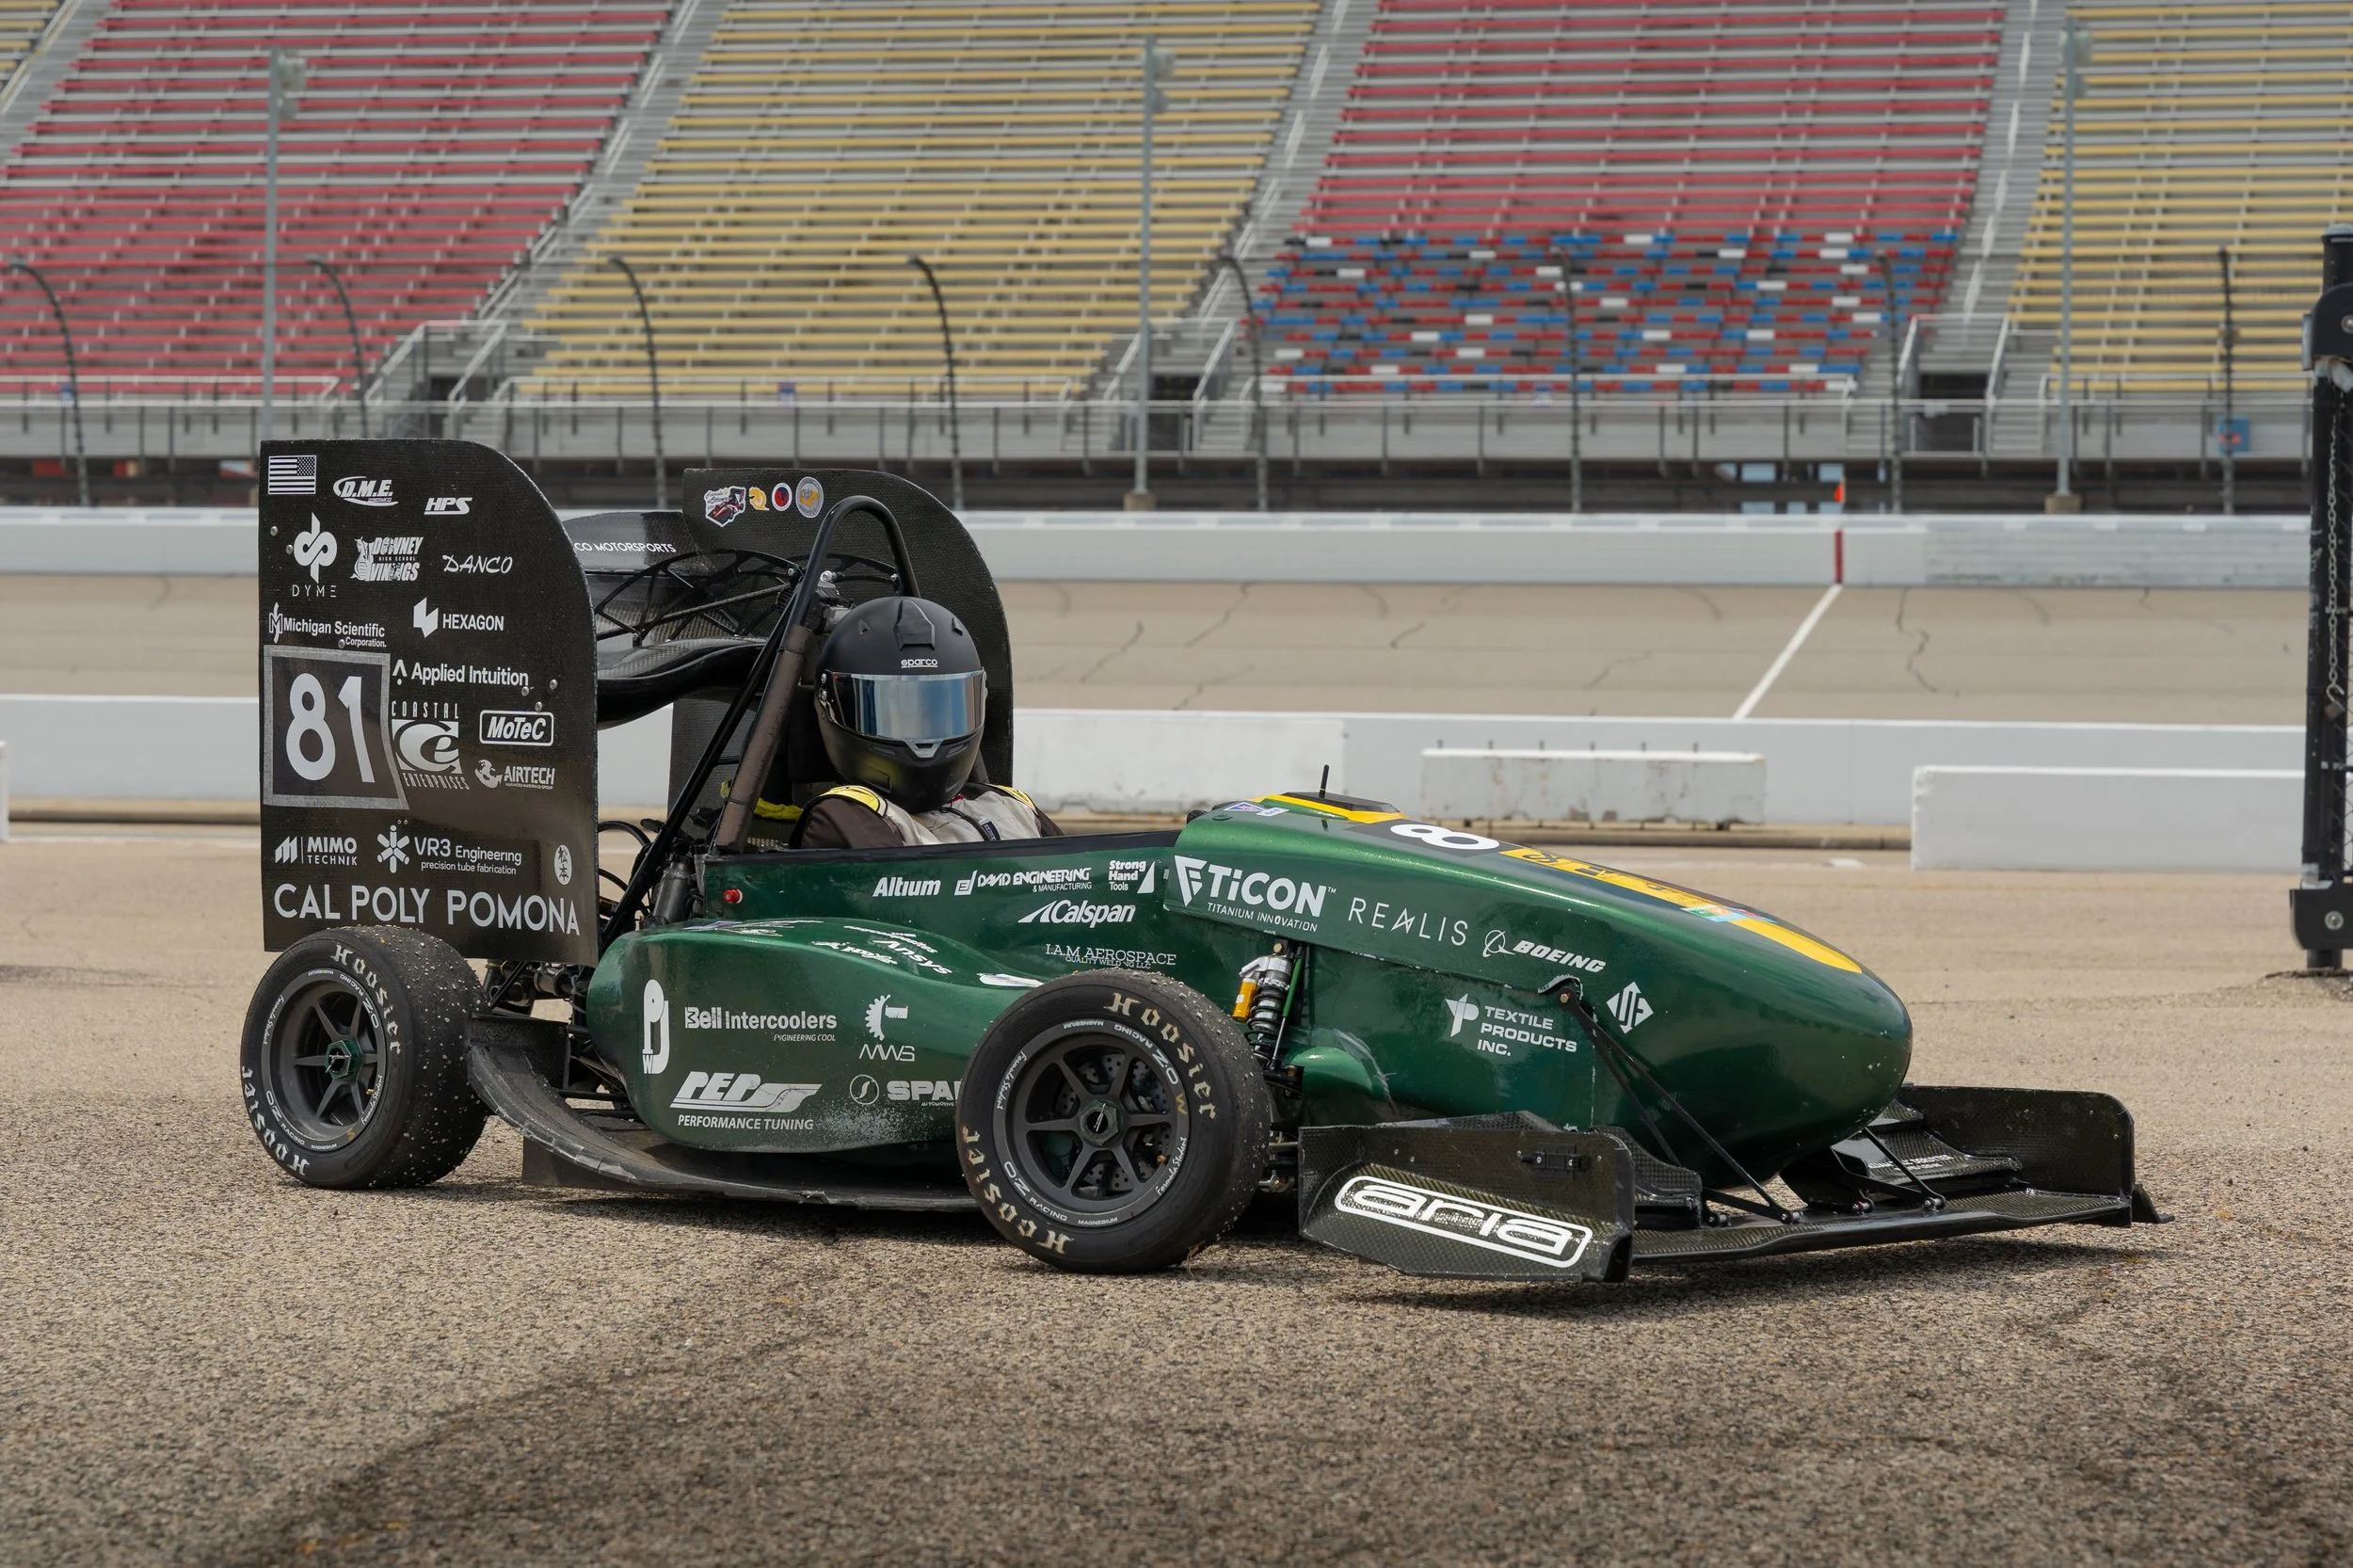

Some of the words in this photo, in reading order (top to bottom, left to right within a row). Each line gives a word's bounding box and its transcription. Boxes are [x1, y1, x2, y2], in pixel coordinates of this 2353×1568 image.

[341, 479, 393, 498] D.M.E.
[424, 497, 472, 515] HPS
[372, 536, 424, 554] DOWNEY
[593, 542, 677, 553] MOTORSPORTS
[369, 562, 421, 581] VIKINGS
[442, 554, 513, 574] DANCO
[292, 584, 337, 598] DYME
[283, 617, 331, 636] Michigan
[334, 621, 386, 637] Scientific
[442, 614, 504, 632] HEXAGON
[345, 636, 387, 648] Corporation.
[411, 662, 466, 685] Applied
[469, 664, 529, 686] Intuition
[392, 700, 459, 719] COASTAL
[286, 673, 376, 783] 81
[487, 716, 546, 741] MoTeC
[403, 773, 470, 791] ENTERPRISES
[504, 765, 555, 785] AIRTECH
[307, 837, 358, 854] MIMO
[414, 837, 451, 857] VR3
[456, 845, 522, 866] Engineering
[307, 855, 358, 866] TECHNIK
[421, 860, 456, 872] precision
[457, 862, 475, 872] tube
[477, 863, 517, 875] fabrication
[1109, 860, 1146, 872] Strong
[977, 872, 1012, 888] DAVID
[1013, 868, 1092, 886] ENGINEERING
[1108, 871, 1138, 881] Hand
[872, 876, 941, 897] Altium
[1038, 881, 1092, 892] MANUFACTURING
[1109, 881, 1128, 891] Tools
[274, 883, 341, 920] CAL
[351, 885, 430, 924] POLY
[447, 889, 581, 936] POMONA
[1049, 899, 1136, 928] Calspan
[1207, 902, 1254, 920] TITANIUM
[1257, 911, 1318, 933] INNOVATION
[1046, 944, 1080, 958] I.A.M
[1083, 947, 1176, 966] AEROSPACE
[1065, 956, 1097, 965] QUALITY
[1513, 940, 1606, 972] BOEING
[340, 973, 364, 997] RACING
[685, 1007, 722, 1029] Bell
[725, 1011, 838, 1030] Intercoolers
[1064, 1020, 1104, 1030] MAGNESIUM
[1484, 1005, 1554, 1031] TEXTILE
[1114, 1024, 1153, 1048] RACING
[1481, 1022, 1577, 1053] PRODUCTS
[1477, 1039, 1512, 1056] INC.
[678, 1114, 764, 1129] PERFORMANCE
[764, 1118, 815, 1129] TUNING
[281, 1122, 306, 1145] RACING
[1030, 1196, 1068, 1222] RACING
[1078, 1217, 1118, 1225] MAGNESIUM
[1354, 1185, 1573, 1256] aria
